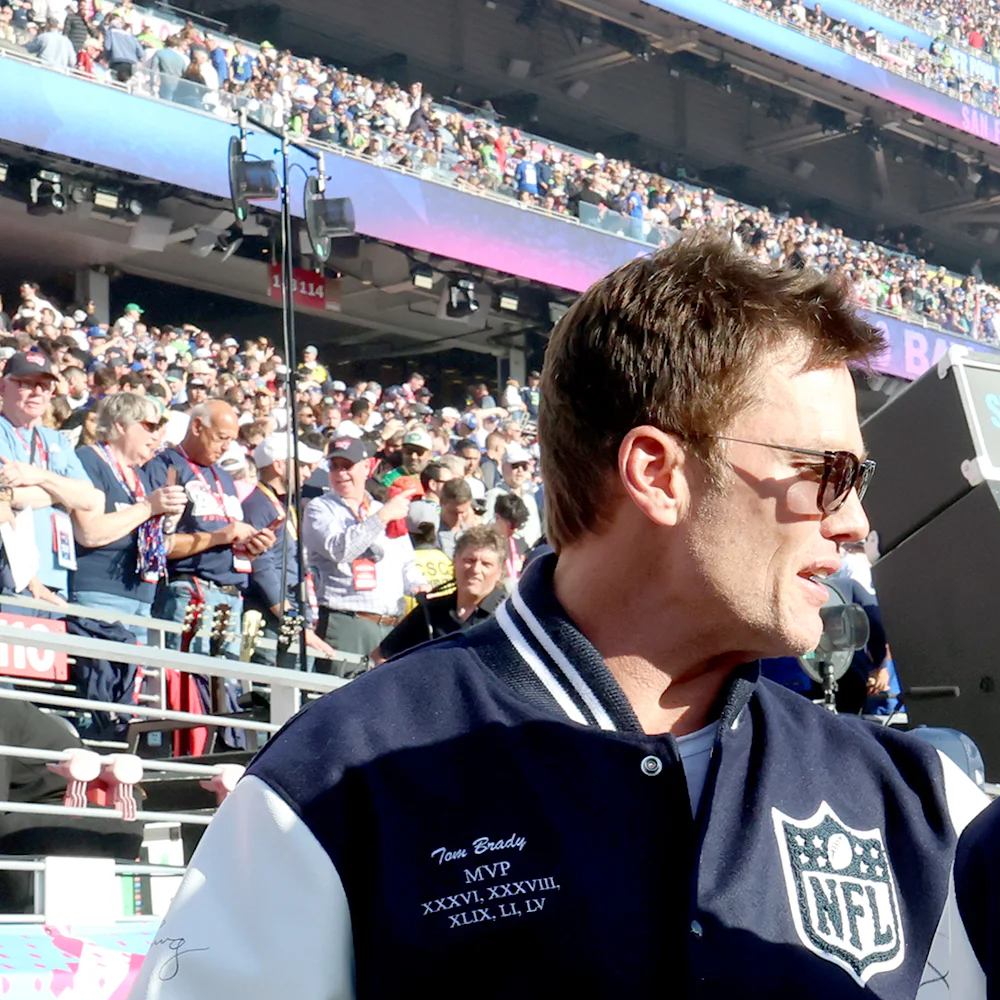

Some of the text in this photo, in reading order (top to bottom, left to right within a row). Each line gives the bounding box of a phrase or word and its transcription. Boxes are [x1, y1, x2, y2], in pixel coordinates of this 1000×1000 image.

[960, 106, 988, 137] SAN
[299, 280, 325, 298] 114
[430, 832, 527, 866] Tom Brady
[463, 860, 511, 884] MVP
[420, 876, 561, 916] XXXVI, XXXVIII,
[448, 897, 546, 929] XLIX, LI, LV
[807, 875, 894, 952] NFL
